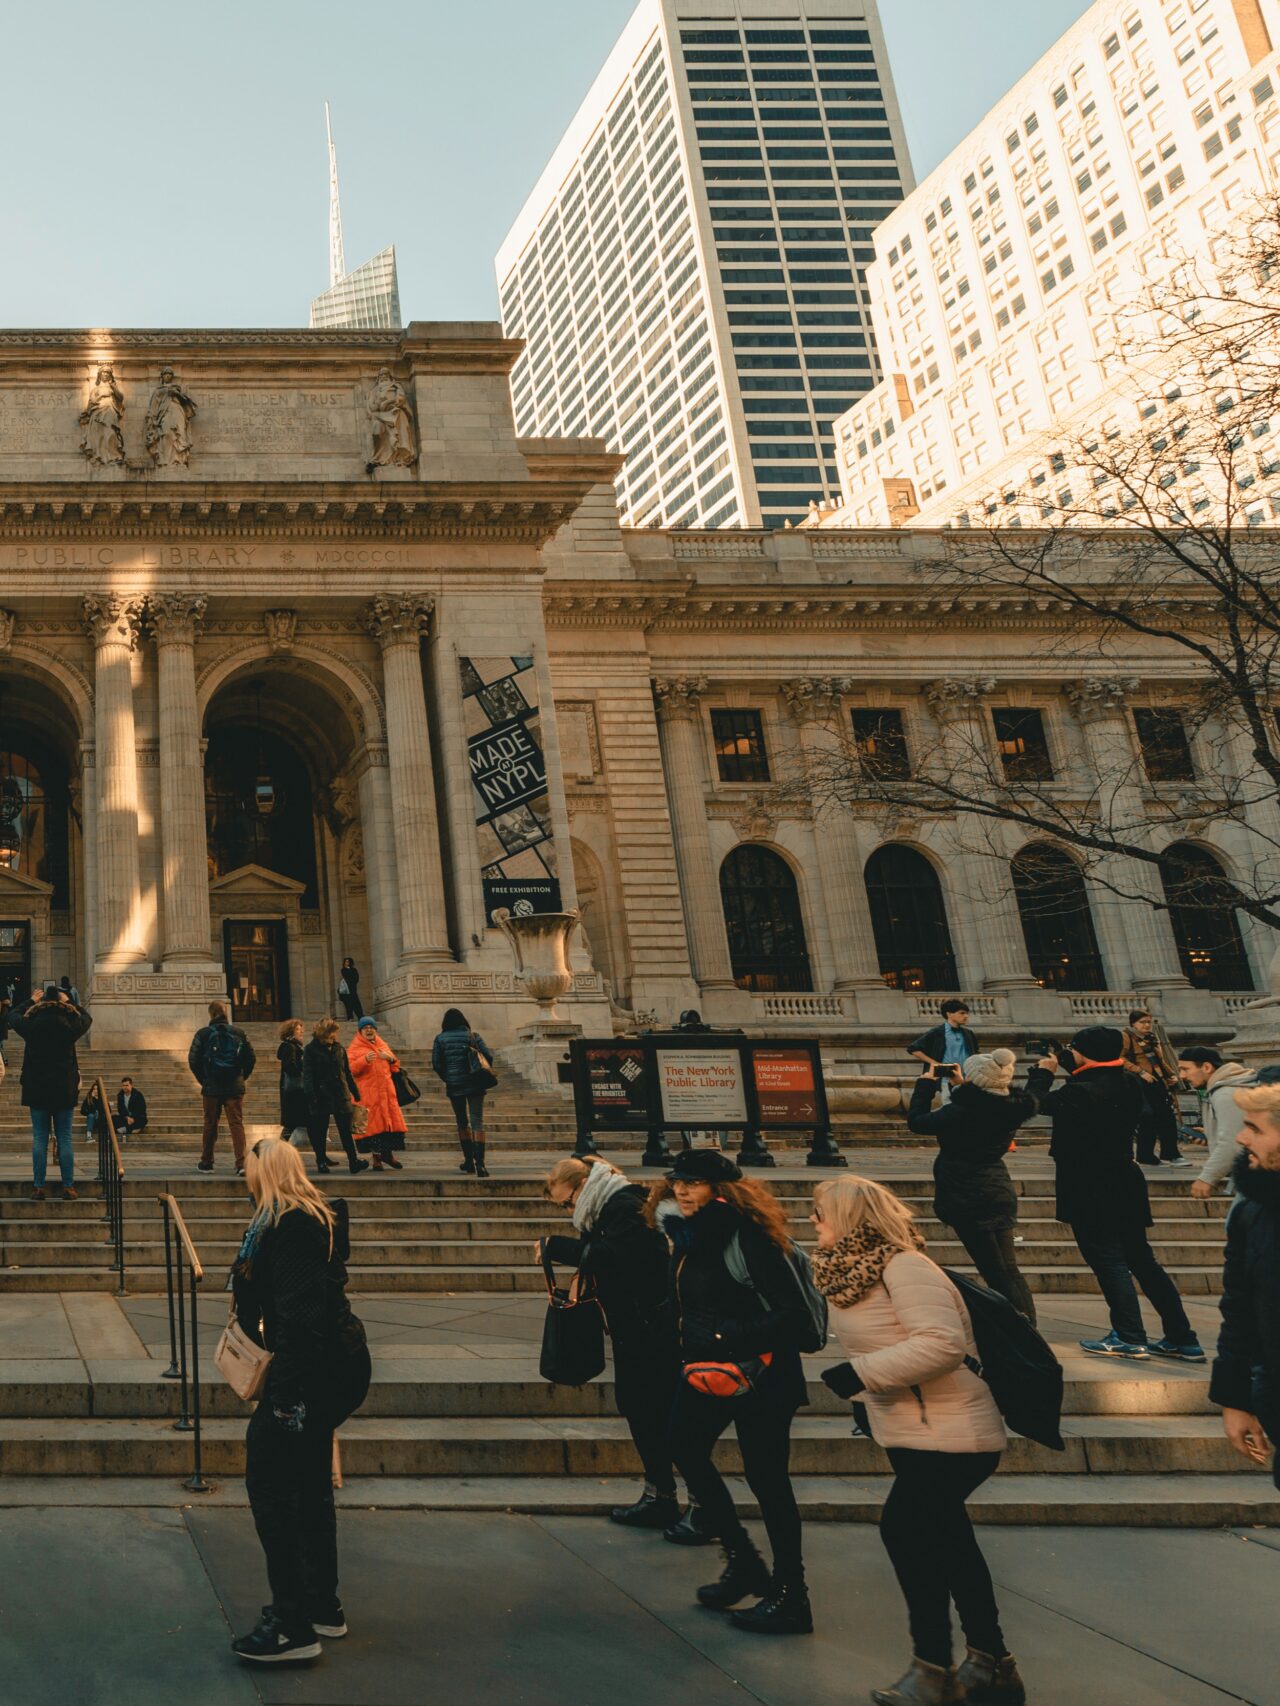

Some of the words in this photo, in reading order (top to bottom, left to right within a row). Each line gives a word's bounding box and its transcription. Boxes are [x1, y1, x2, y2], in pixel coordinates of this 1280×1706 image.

[15, 392, 74, 406] LIBRARY
[197, 393, 225, 406] THE
[238, 393, 288, 406] TILDEN
[300, 393, 345, 406] TRUST
[16, 547, 114, 566] PUBLIC
[141, 547, 257, 566] LIBRARY
[316, 549, 411, 564] MDCCCCII
[469, 729, 531, 773] MADE
[501, 760, 511, 770] AT
[482, 761, 548, 804] NYPL
[491, 886, 508, 894] FREE
[509, 886, 551, 894] EXHIBITION
[664, 1066, 685, 1076] The
[687, 1066, 710, 1076] New
[712, 1065, 736, 1076] York
[758, 1072, 782, 1080] Library
[666, 1077, 697, 1087] Public
[700, 1077, 736, 1089] Library
